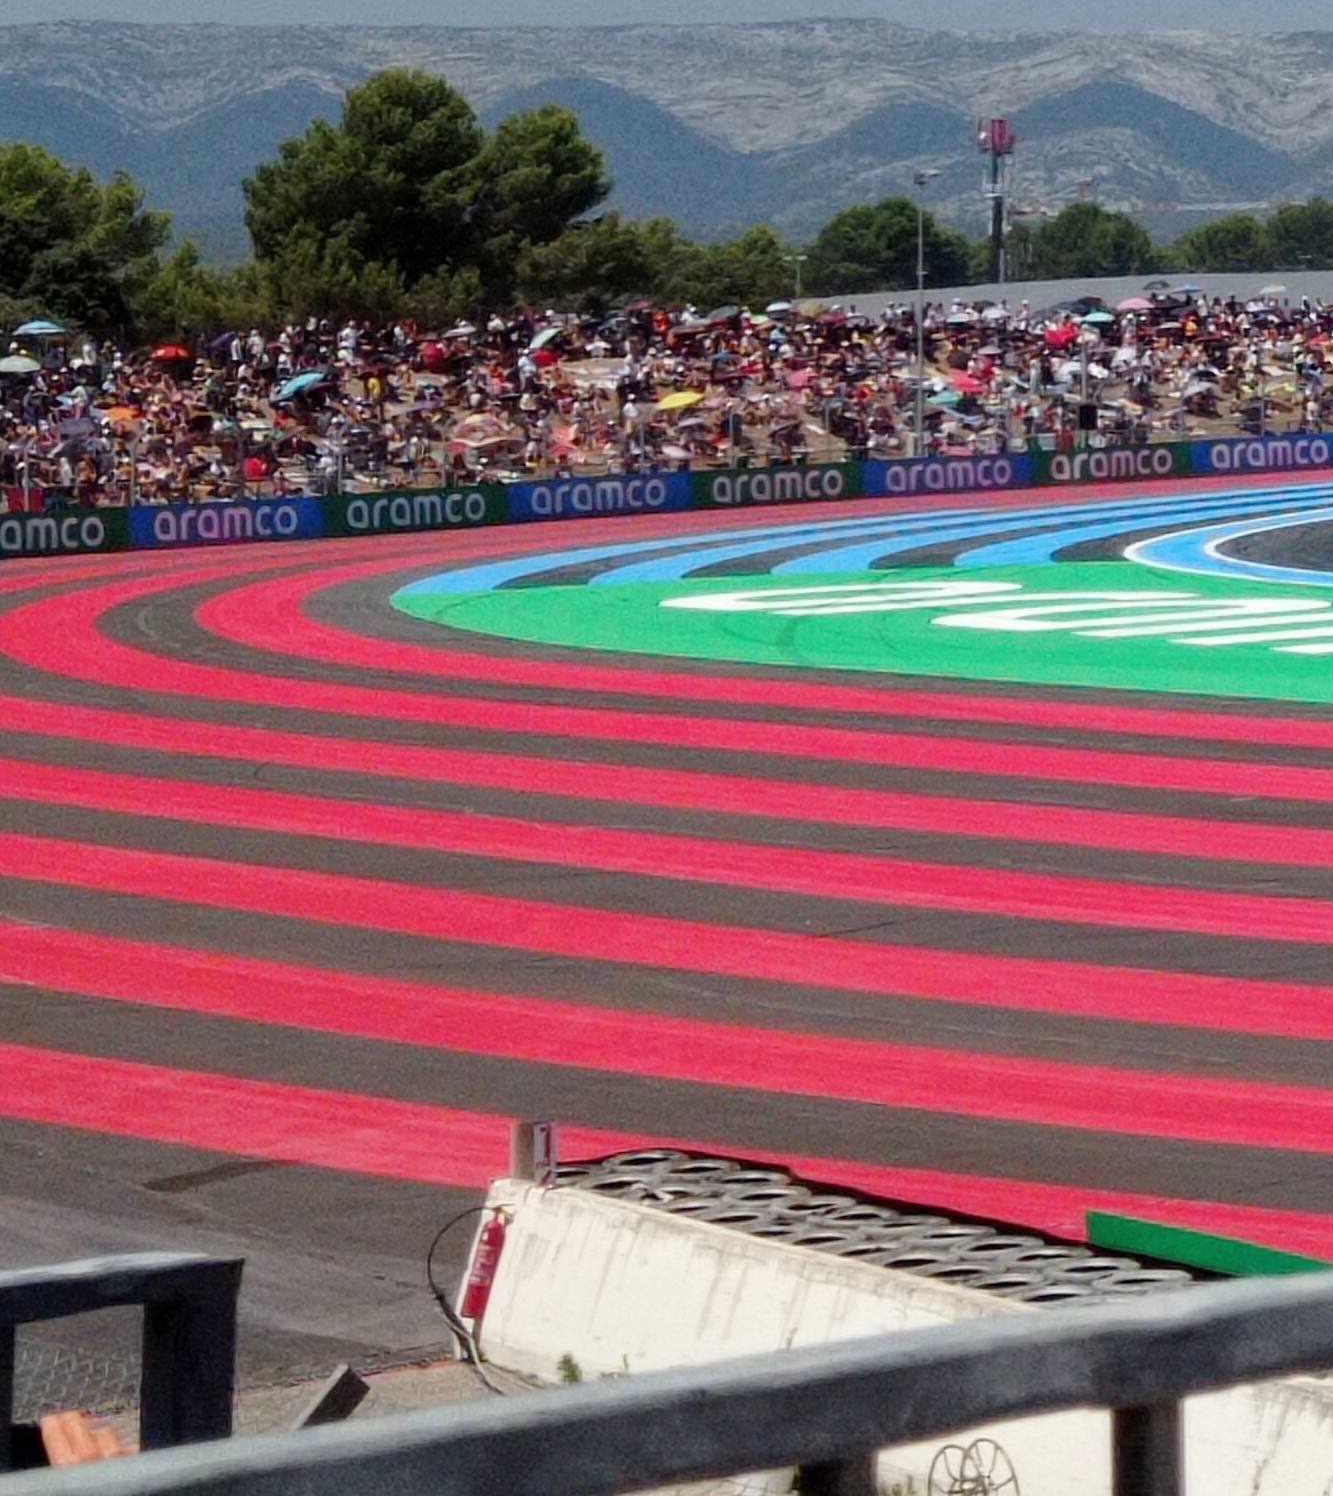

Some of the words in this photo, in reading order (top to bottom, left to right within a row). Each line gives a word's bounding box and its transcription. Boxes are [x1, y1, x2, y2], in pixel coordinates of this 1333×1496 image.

[1051, 447, 1172, 481] aramco
[1211, 439, 1328, 469] aramco
[712, 469, 844, 503] aramco
[886, 458, 1012, 492] aramco
[347, 490, 486, 529] aramco
[531, 477, 666, 515] aramco
[154, 505, 298, 541] aramco
